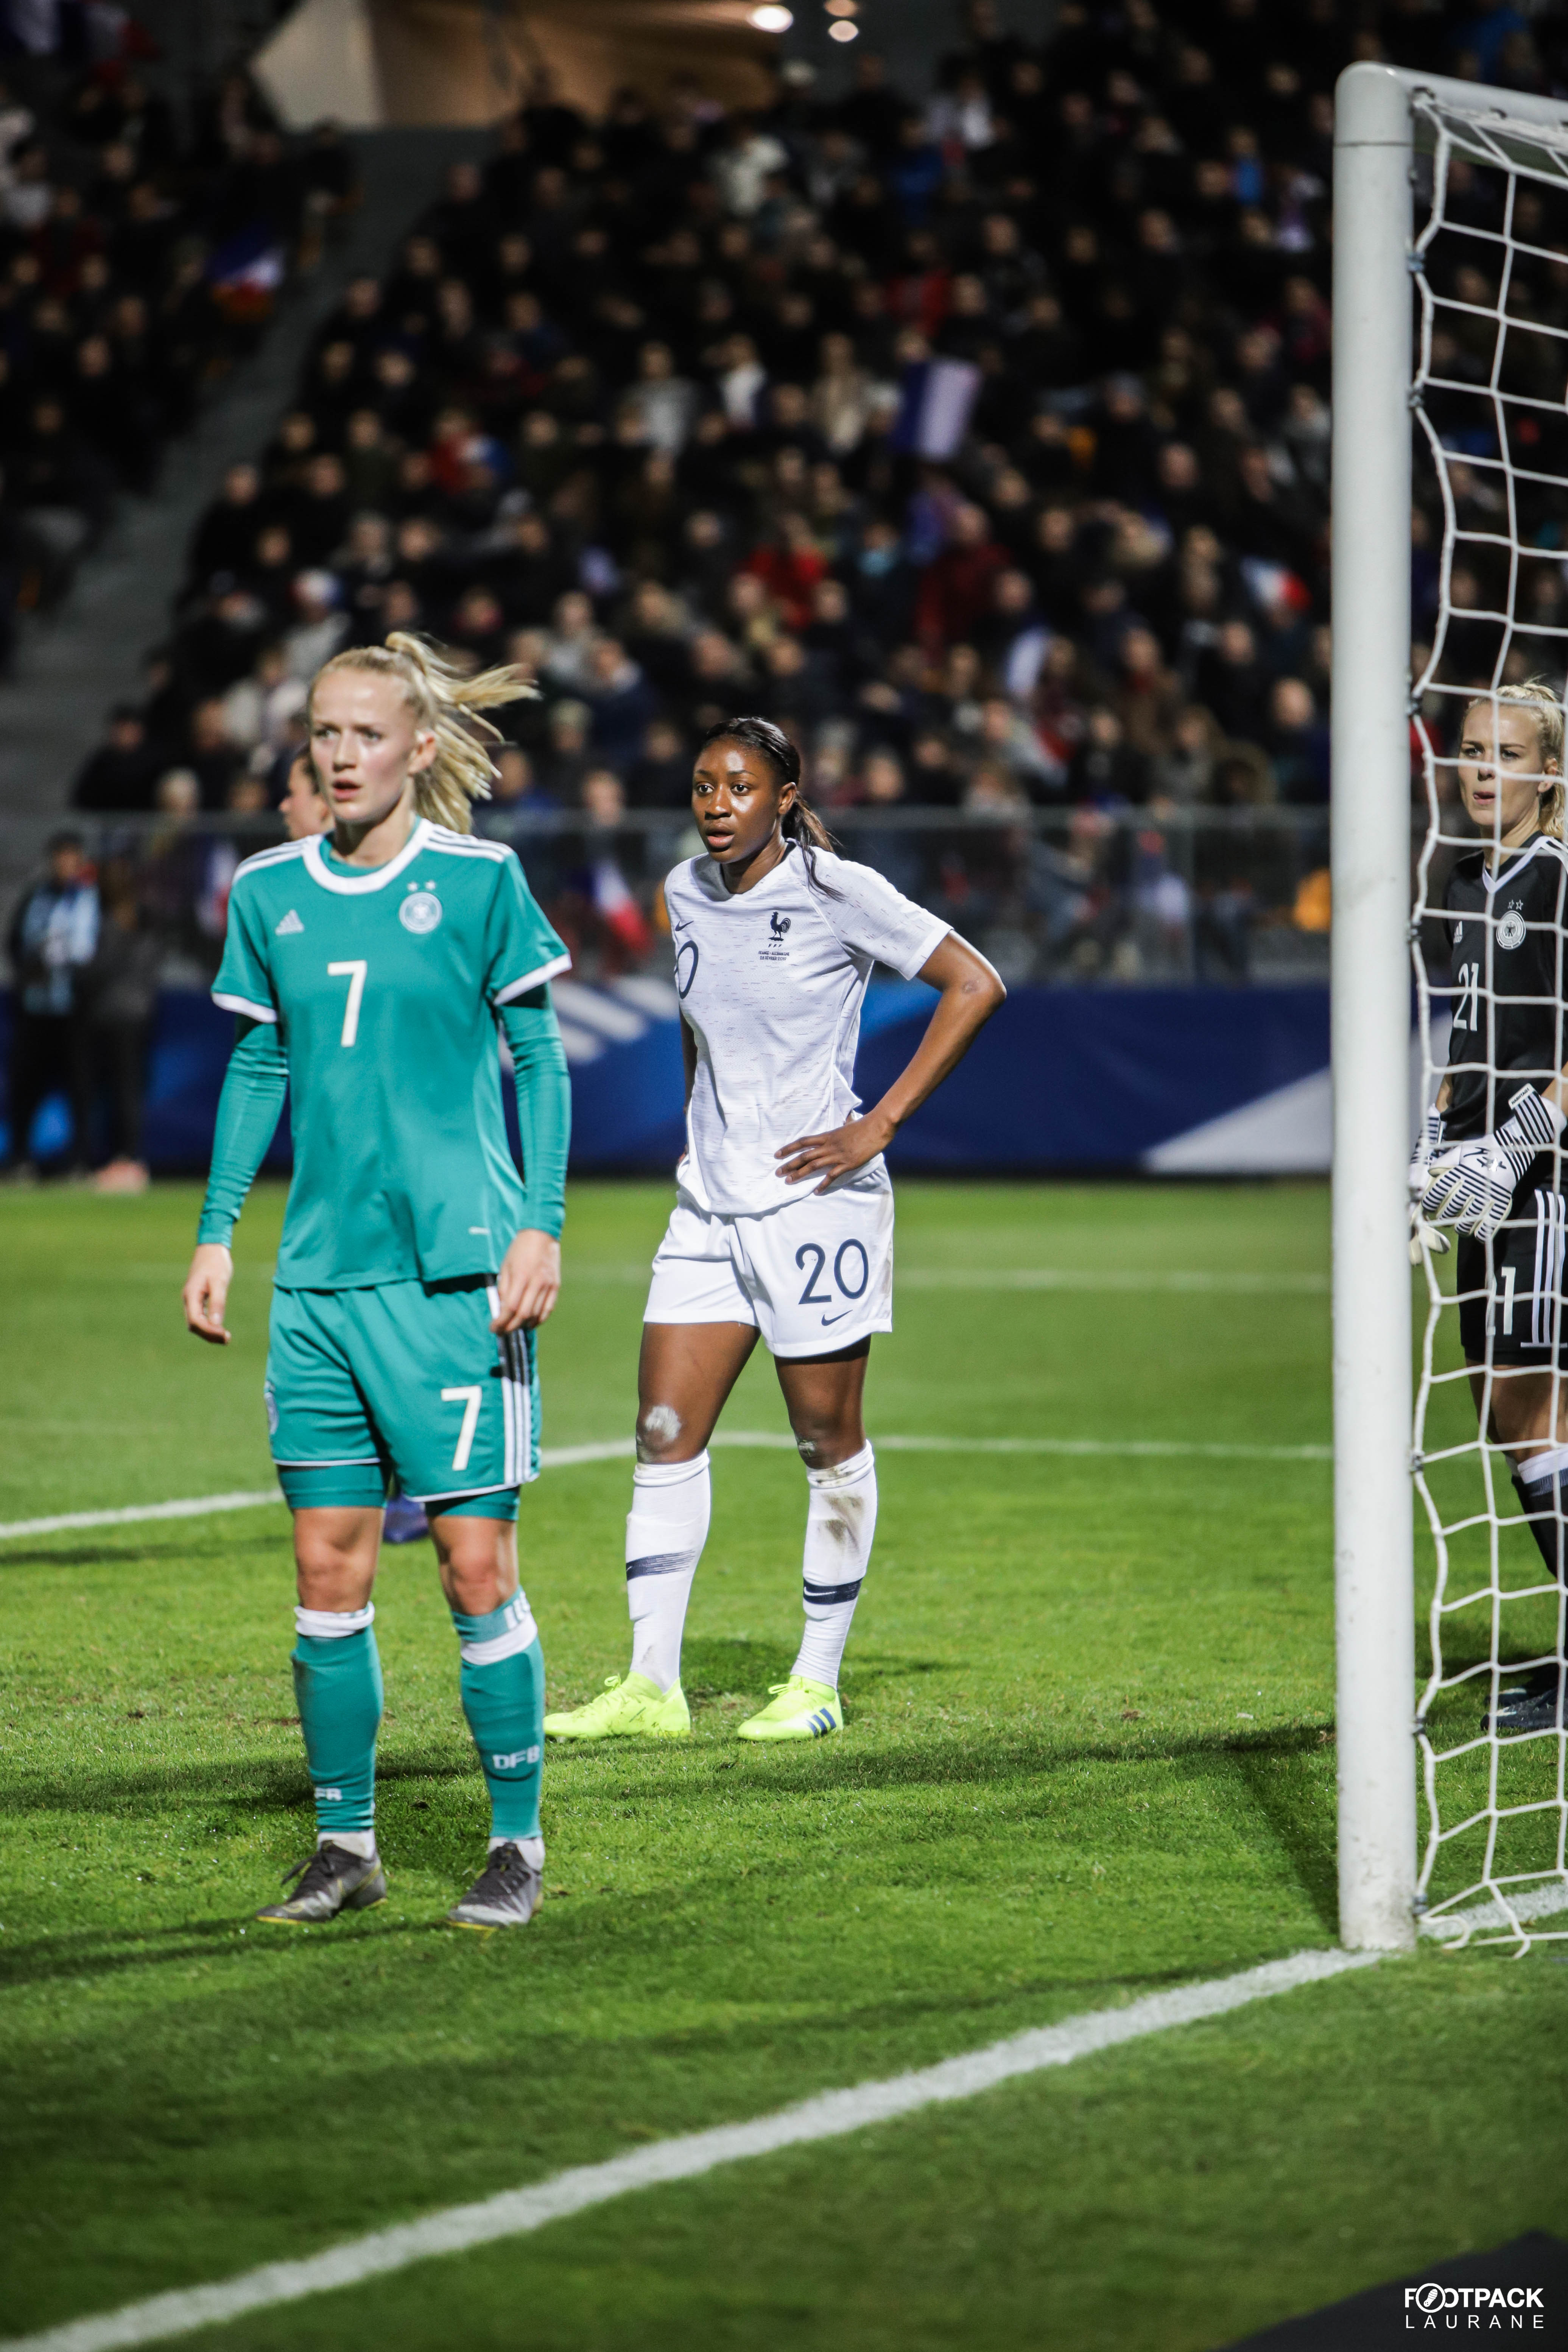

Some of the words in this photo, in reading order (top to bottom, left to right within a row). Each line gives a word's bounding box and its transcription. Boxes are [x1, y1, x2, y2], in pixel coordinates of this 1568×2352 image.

[327, 959, 367, 1047] 7
[674, 940, 699, 999] 0
[1453, 963, 1479, 1031] 21
[795, 1238, 869, 1304] 20
[441, 1385, 482, 1471] 7
[493, 1745, 540, 1769] DFB
